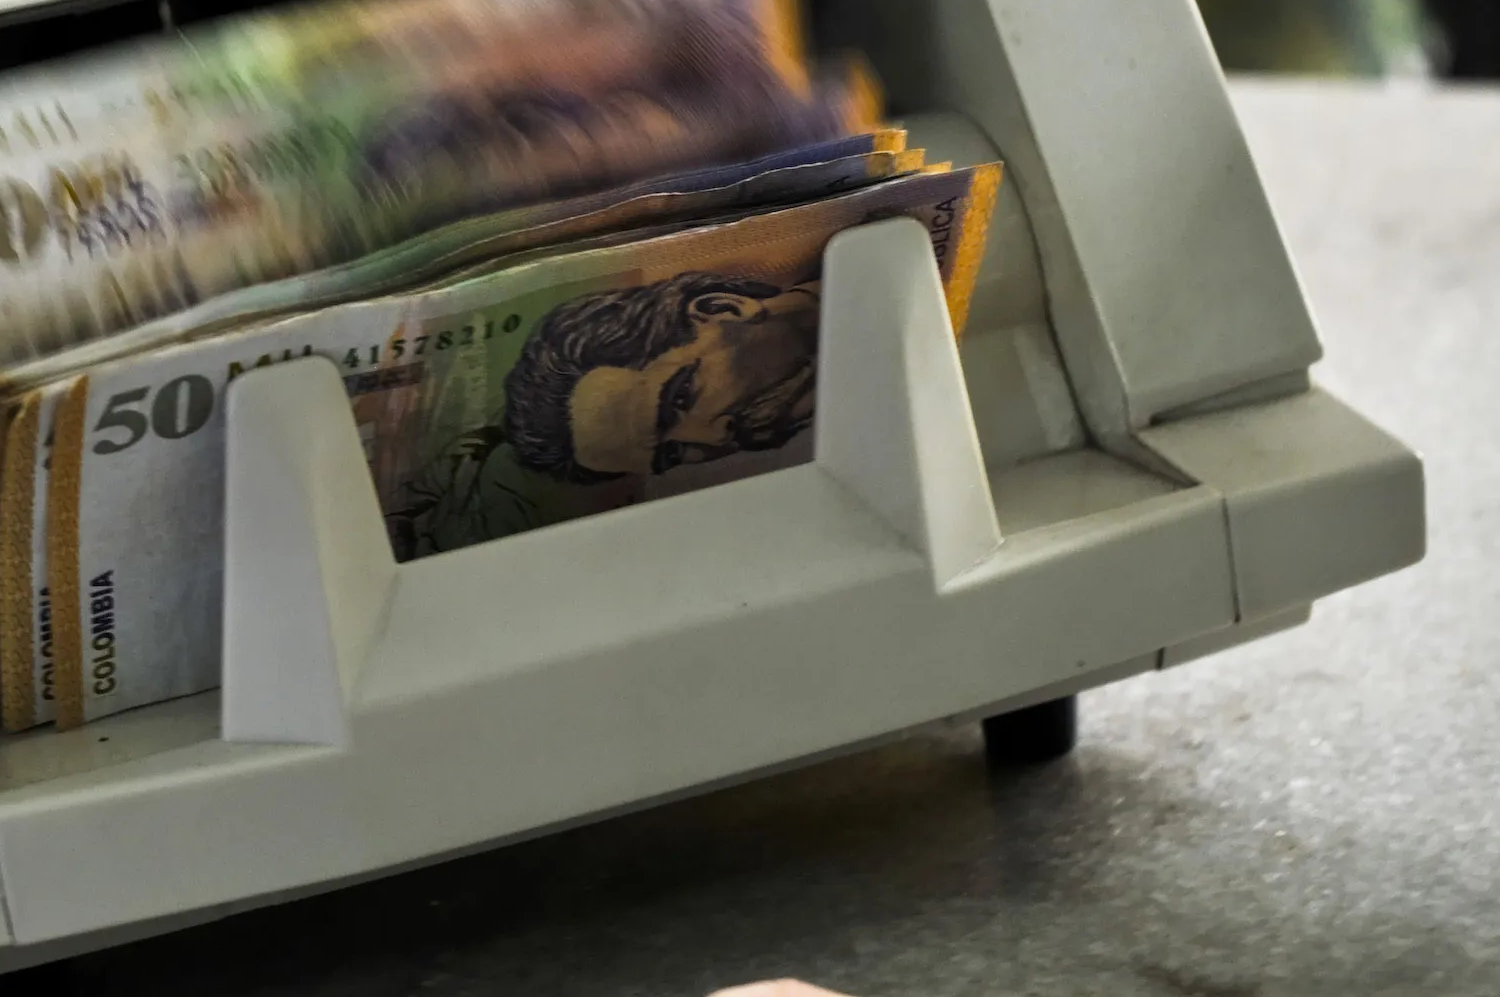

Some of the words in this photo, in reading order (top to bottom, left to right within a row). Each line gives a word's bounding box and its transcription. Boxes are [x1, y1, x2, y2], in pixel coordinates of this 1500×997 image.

[343, 313, 523, 369] 41578210
[92, 373, 215, 456] 50
[88, 569, 116, 696] COLOMBIA
